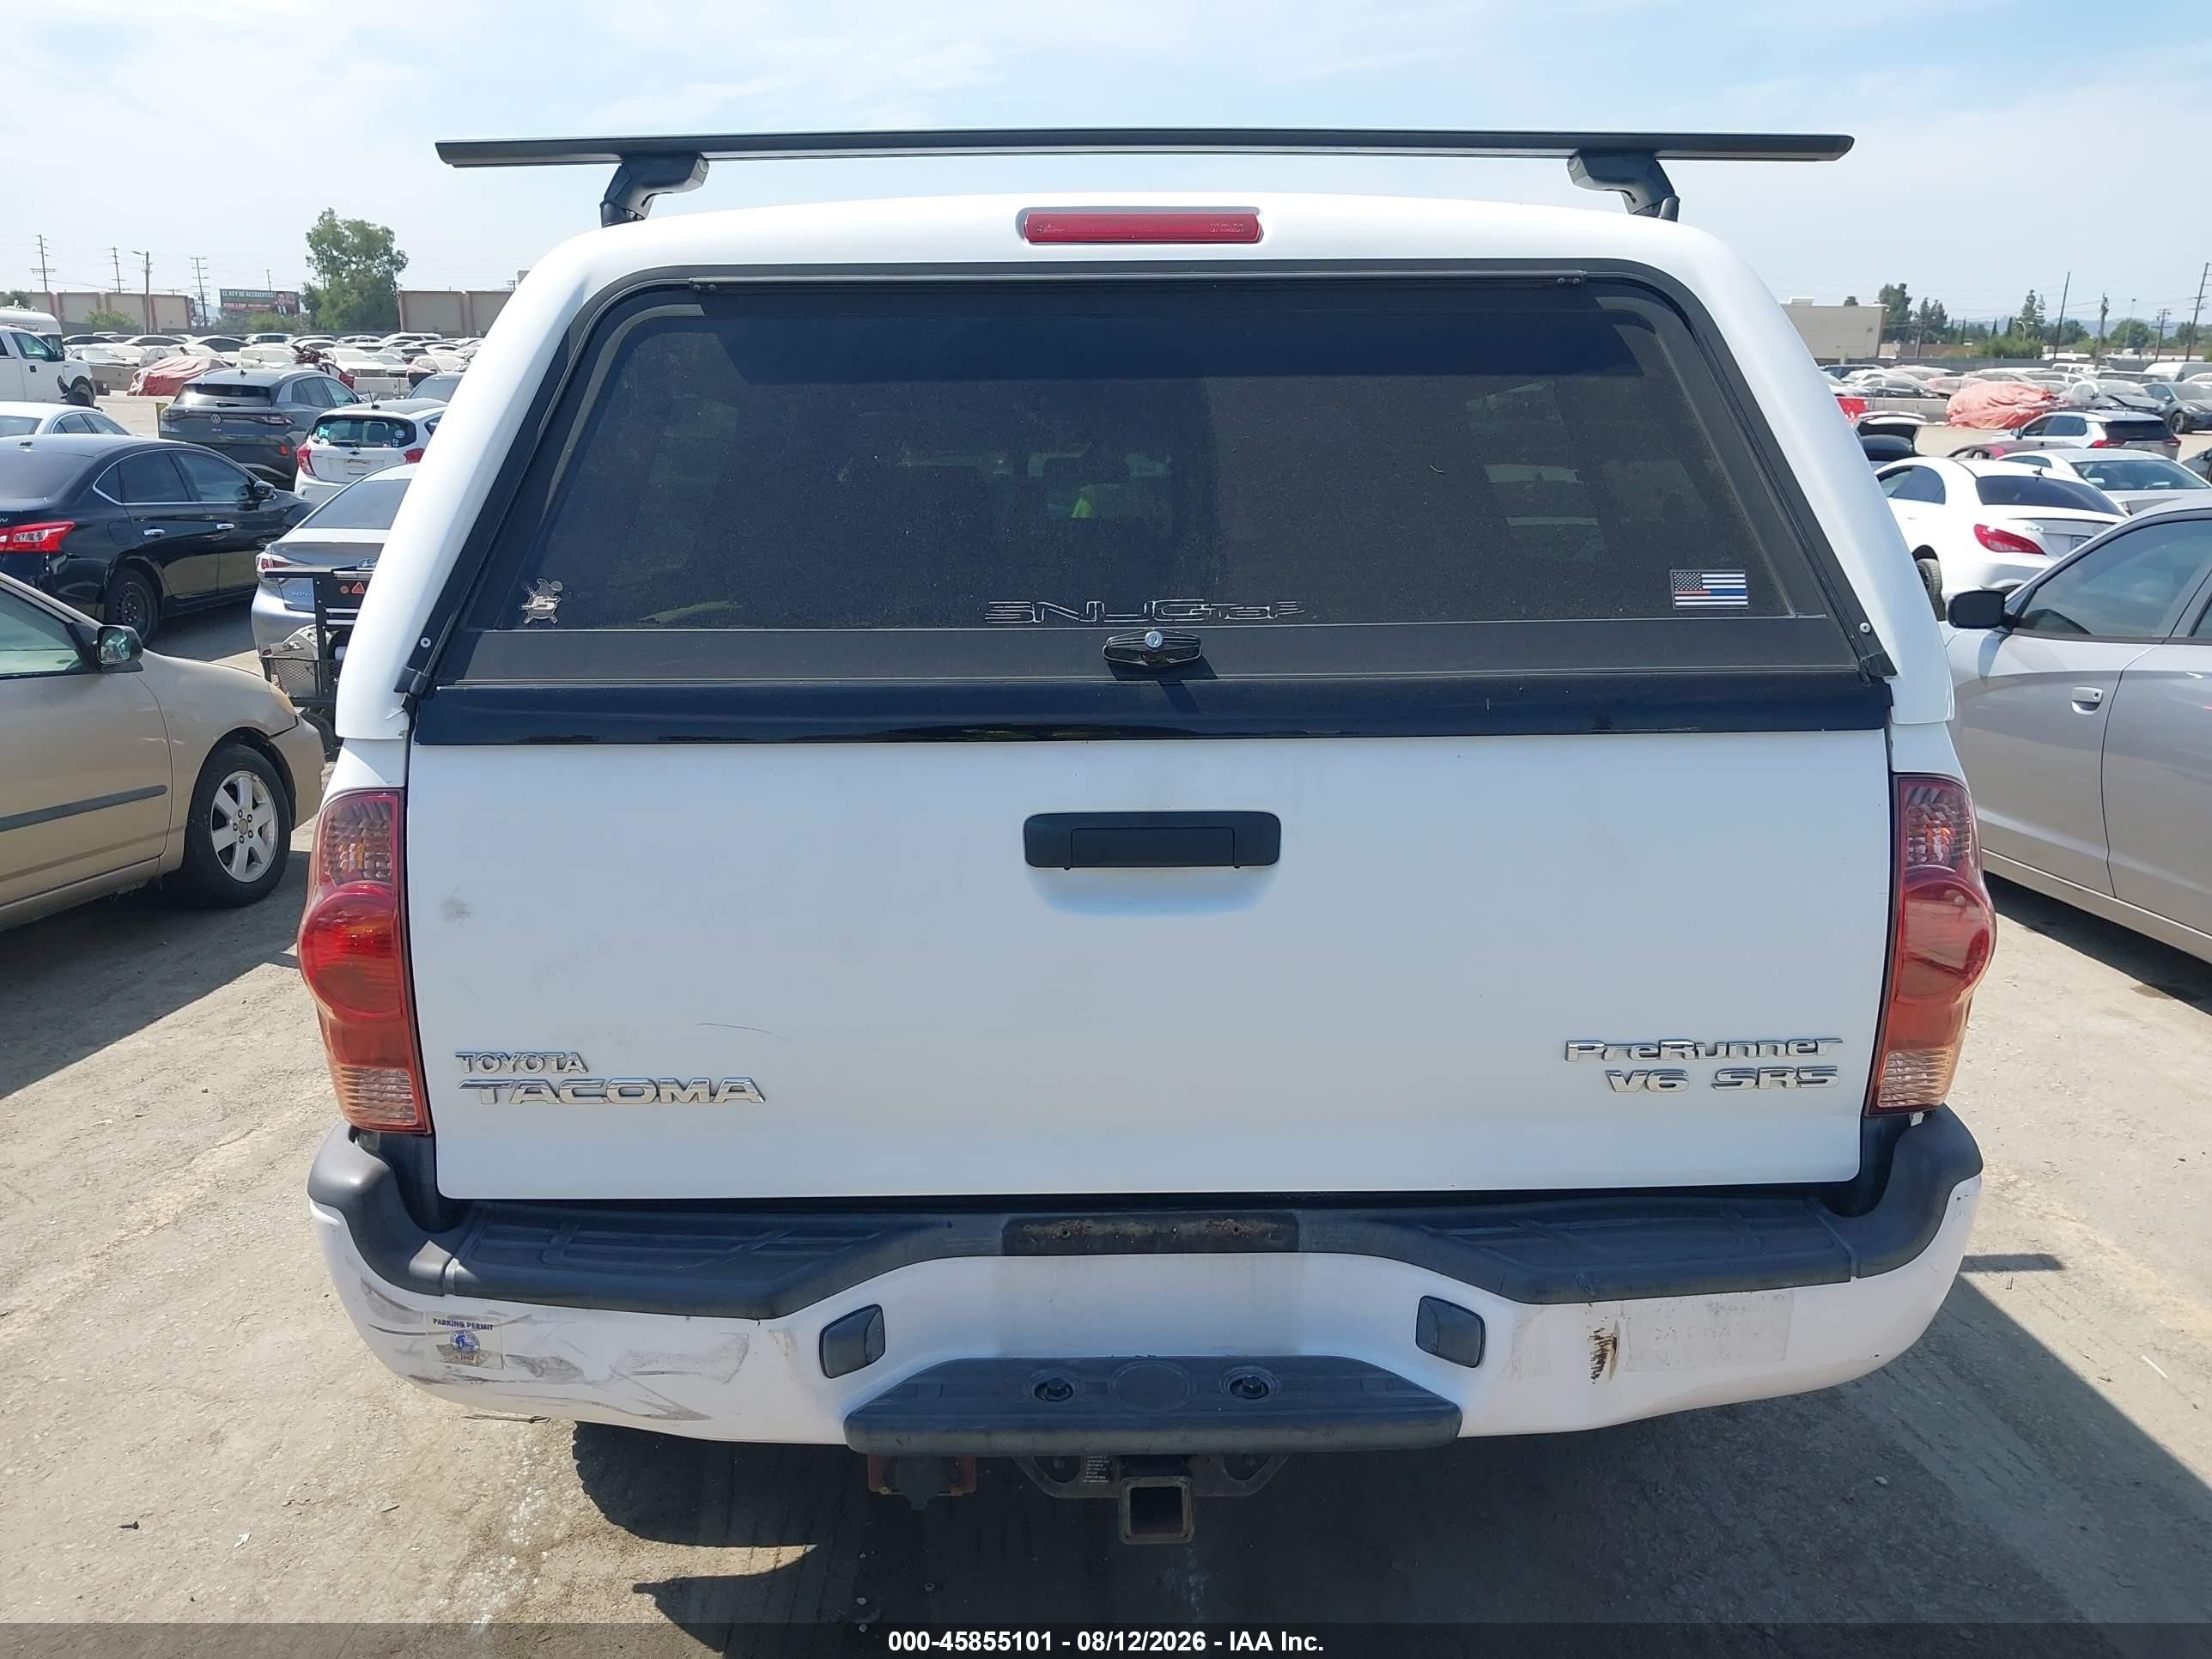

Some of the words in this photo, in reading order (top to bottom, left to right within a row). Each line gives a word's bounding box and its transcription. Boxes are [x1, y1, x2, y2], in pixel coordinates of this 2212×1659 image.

[1565, 1037, 1844, 1062] PreRunner
[454, 1051, 589, 1074] TOYOTA
[458, 1077, 766, 1105] TACOMA
[1606, 1069, 1690, 1093] V6
[1711, 1066, 1841, 1091] SR5
[432, 1317, 465, 1328] PARKING
[466, 1322, 495, 1331] PERMIT
